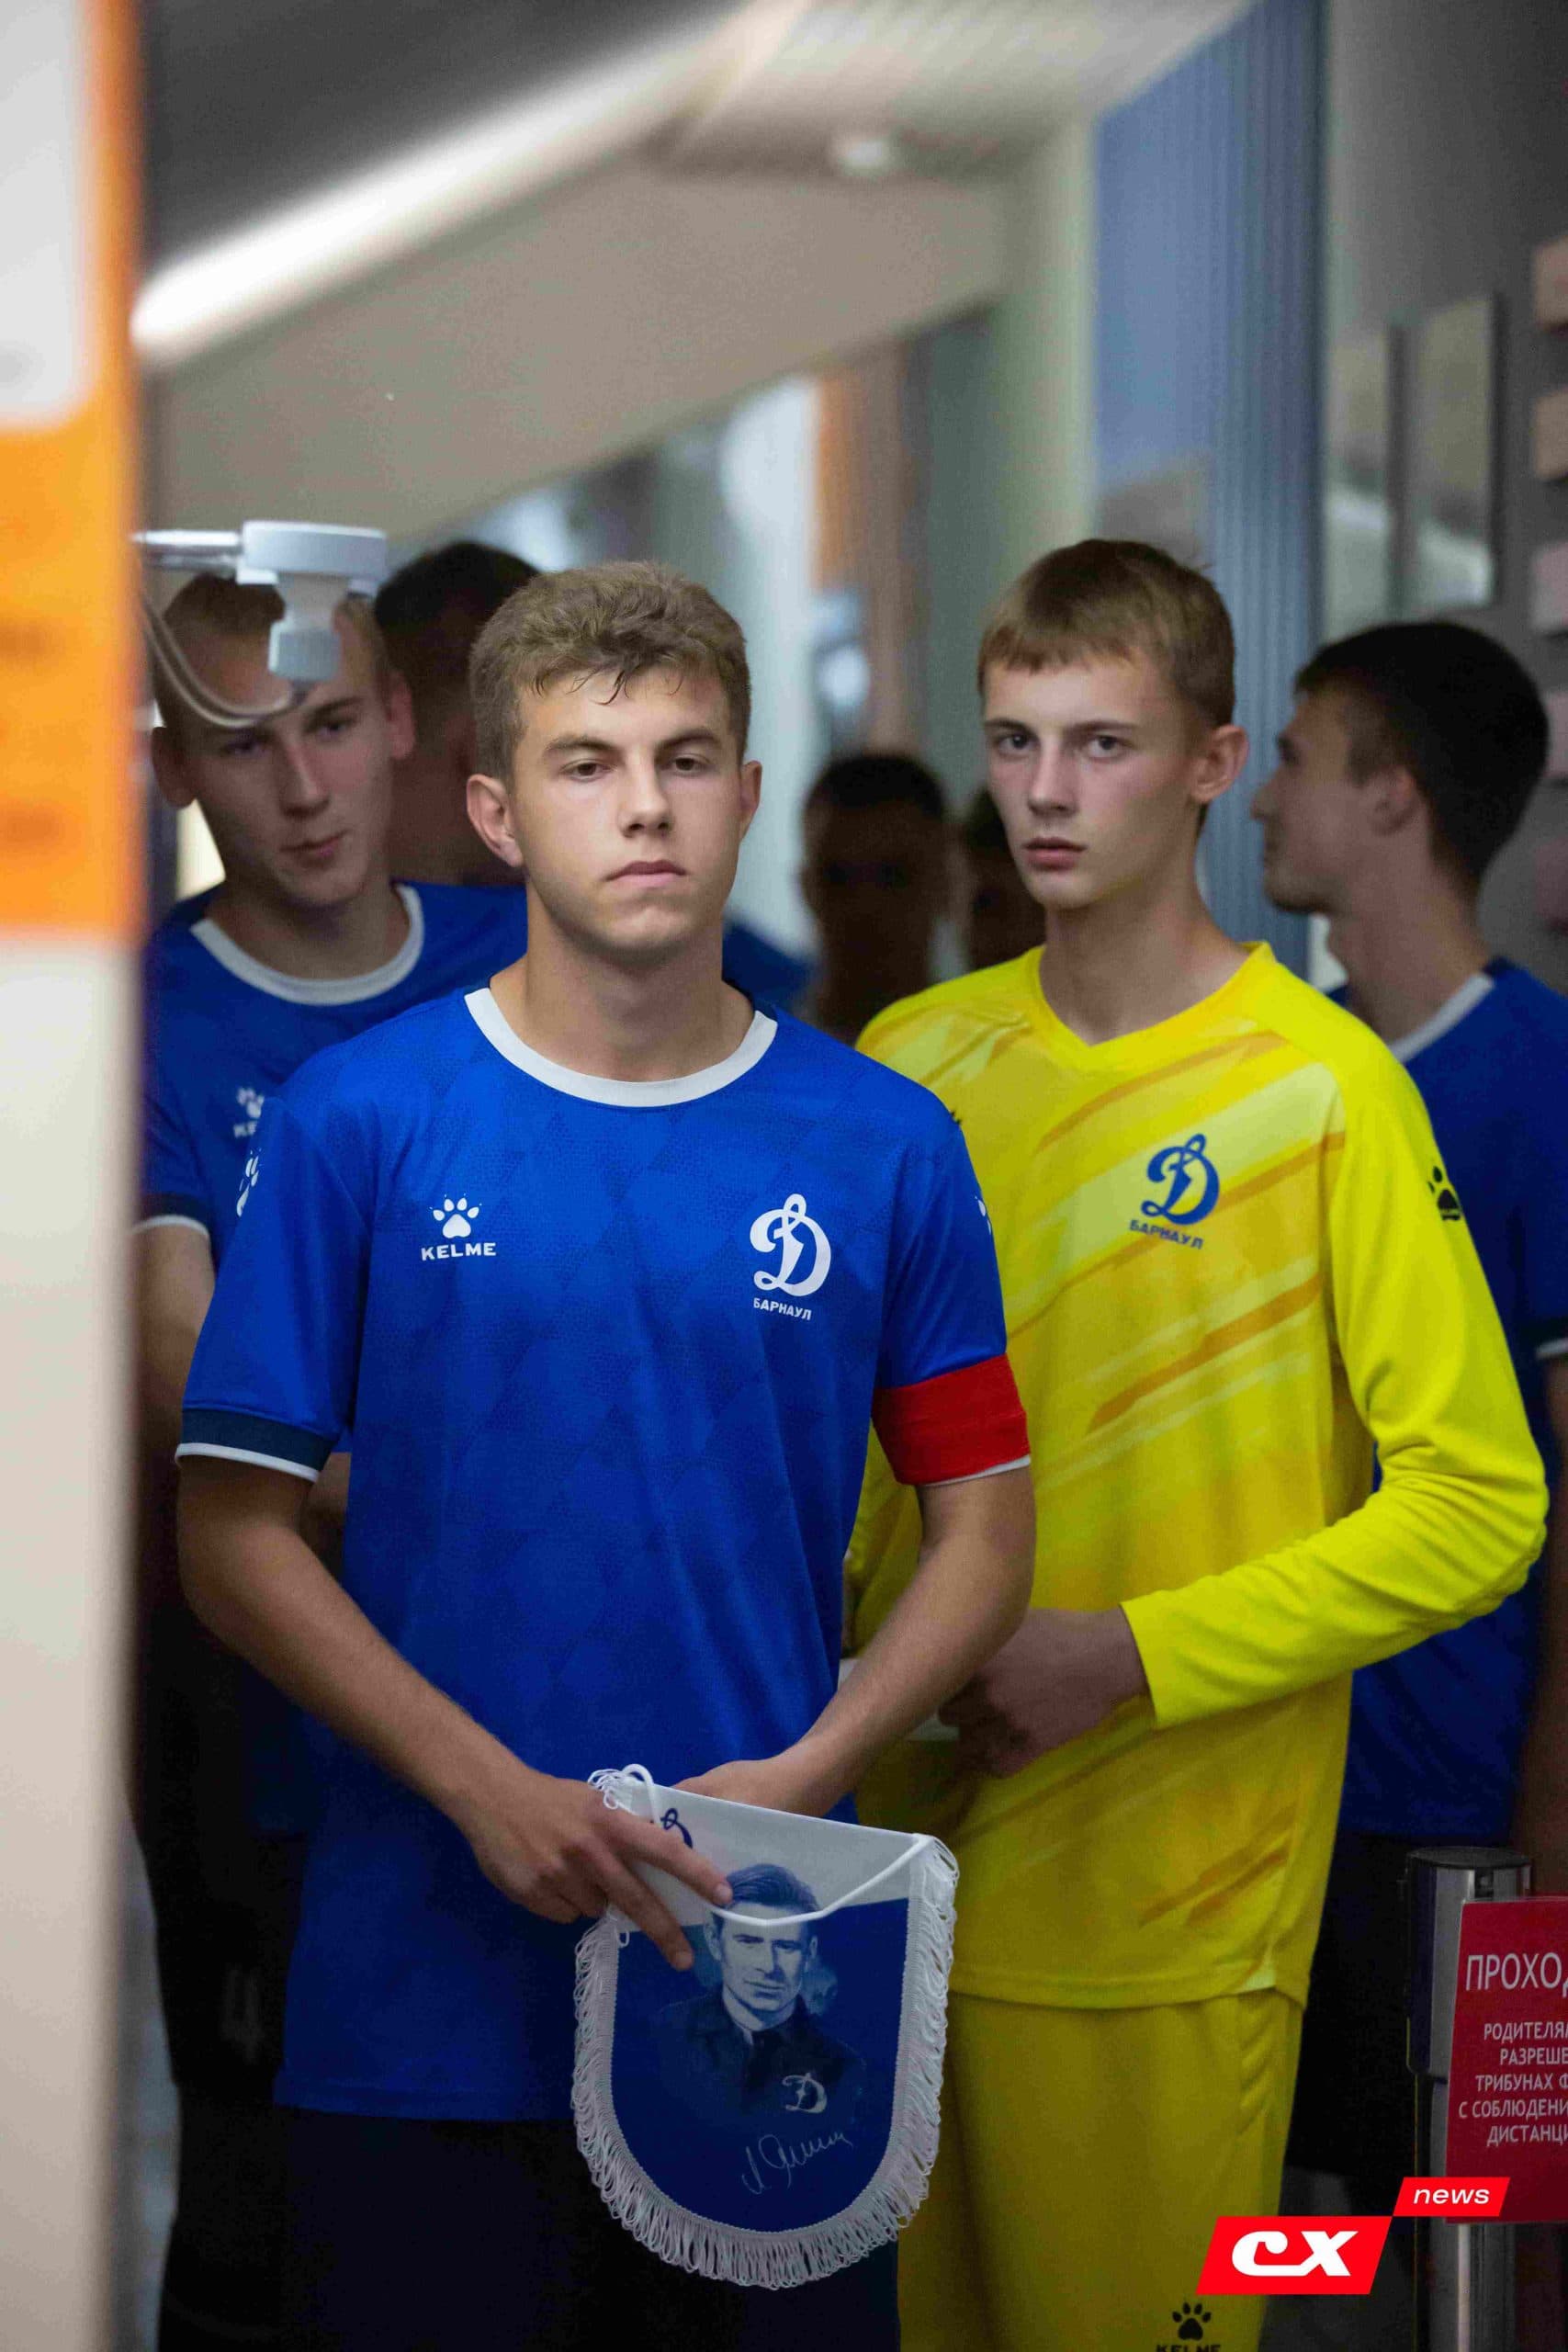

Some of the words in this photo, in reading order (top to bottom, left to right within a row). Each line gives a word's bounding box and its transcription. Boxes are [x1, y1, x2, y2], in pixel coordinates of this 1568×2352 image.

[1129, 1219, 1204, 1250] БАРНАУЛ
[421, 1242, 497, 1261] KELME
[753, 1297, 812, 1320] БАРНАУЛ
[1483, 2021, 1568, 2044] РОДИТЕЛЯ
[1475, 2073, 1554, 2092] ТРИБУНАХ
[1459, 2101, 1469, 2120] С
[1472, 2098, 1568, 2121] СОБЛЮДЕНИ
